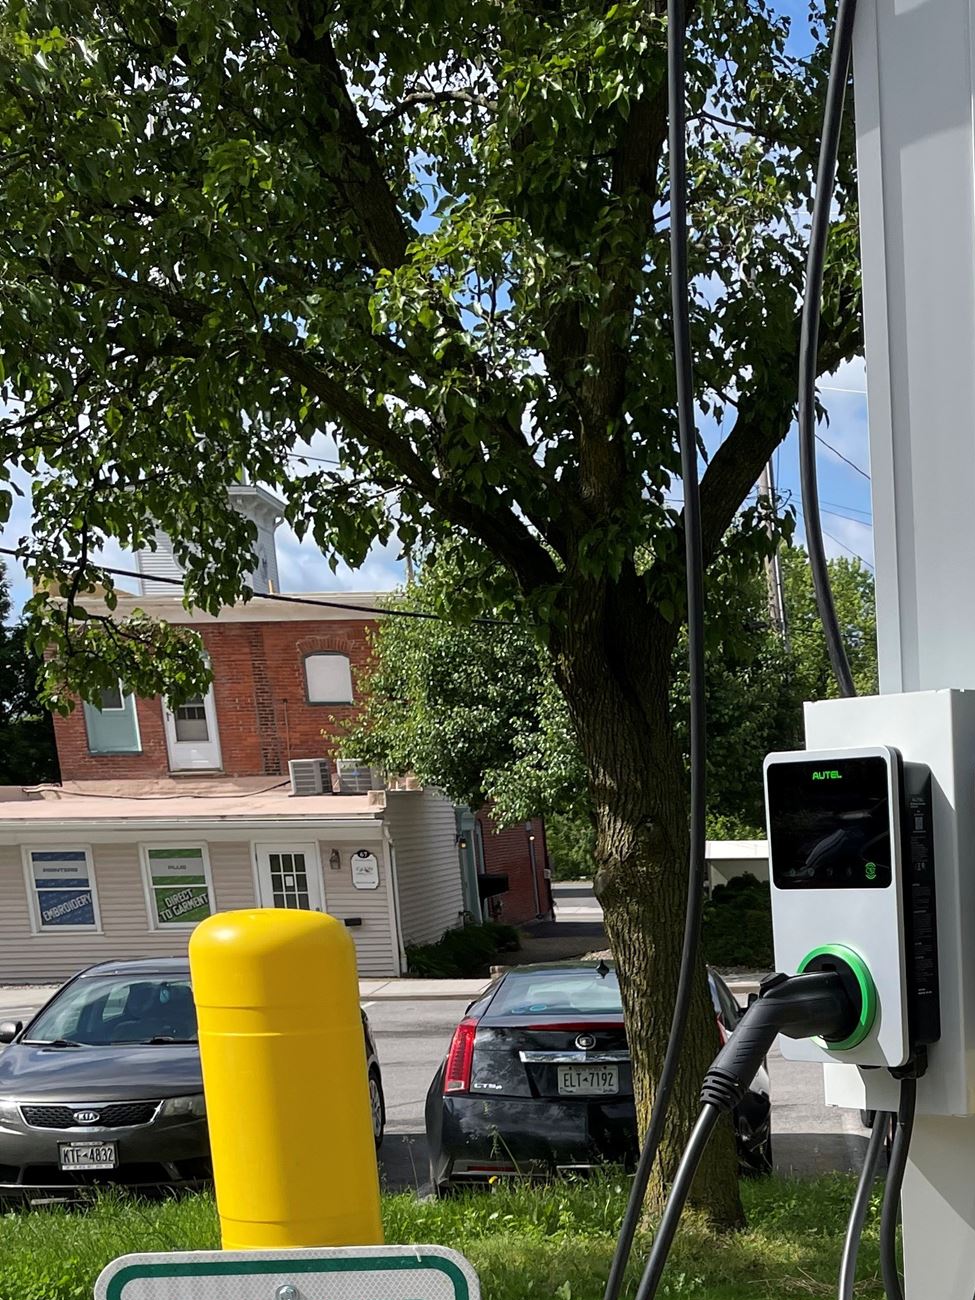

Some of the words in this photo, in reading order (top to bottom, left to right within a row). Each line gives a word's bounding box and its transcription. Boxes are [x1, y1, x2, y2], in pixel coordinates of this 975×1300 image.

[812, 770, 842, 780] AUTEL
[42, 893, 92, 921] EMBROIDERY
[160, 909, 173, 921] TO
[172, 893, 209, 916] GARMENT
[164, 888, 193, 907] DIRECT
[78, 1112, 95, 1120] KIA
